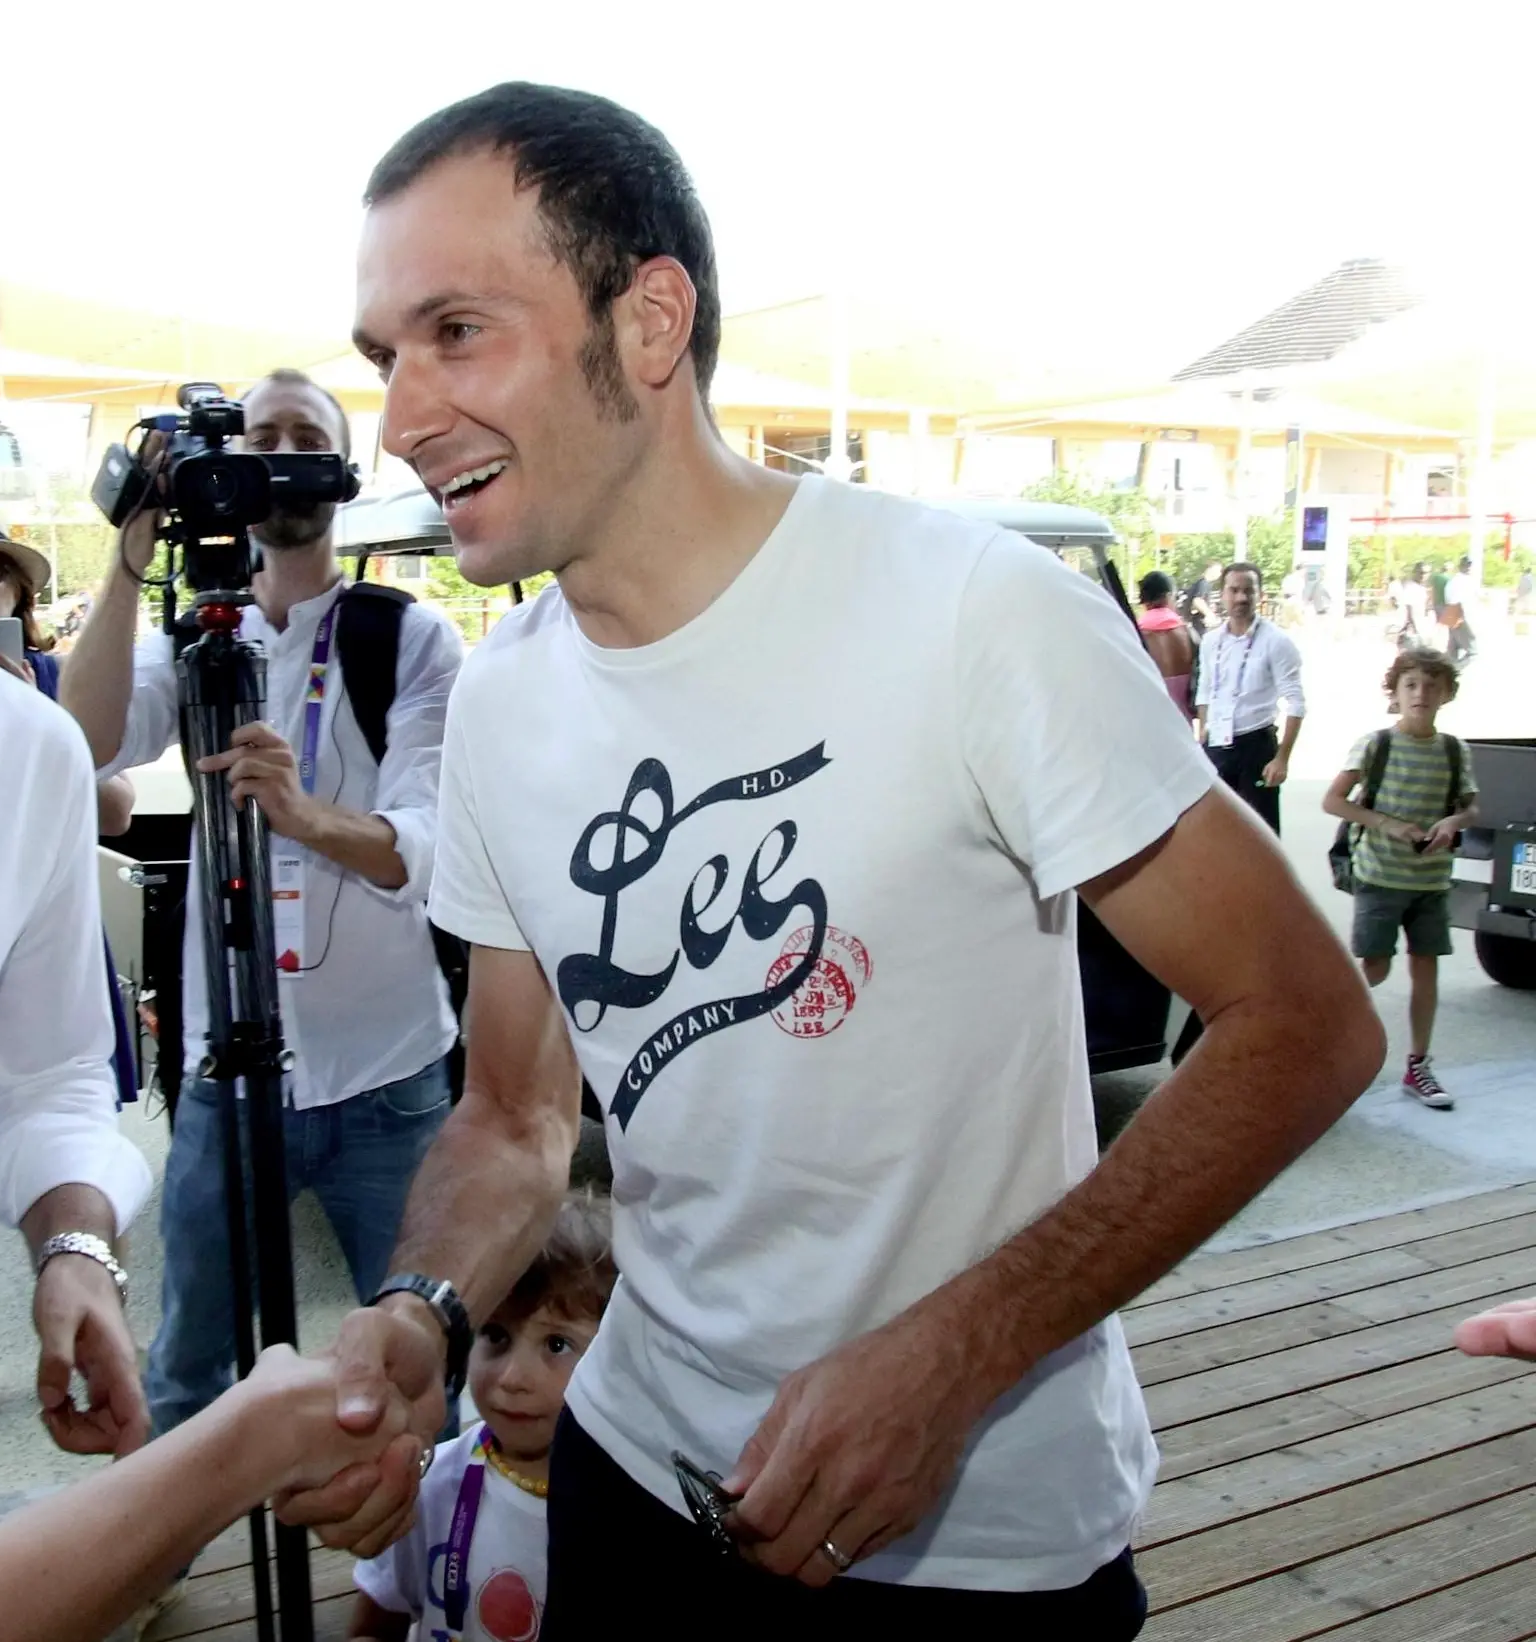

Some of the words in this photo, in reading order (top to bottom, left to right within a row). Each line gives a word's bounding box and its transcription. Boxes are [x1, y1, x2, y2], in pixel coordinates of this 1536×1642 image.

[742, 769, 792, 795] H.D.
[557, 757, 827, 1032] Lee
[627, 1001, 736, 1091] COMPANY
[793, 1022, 825, 1034] LEE
